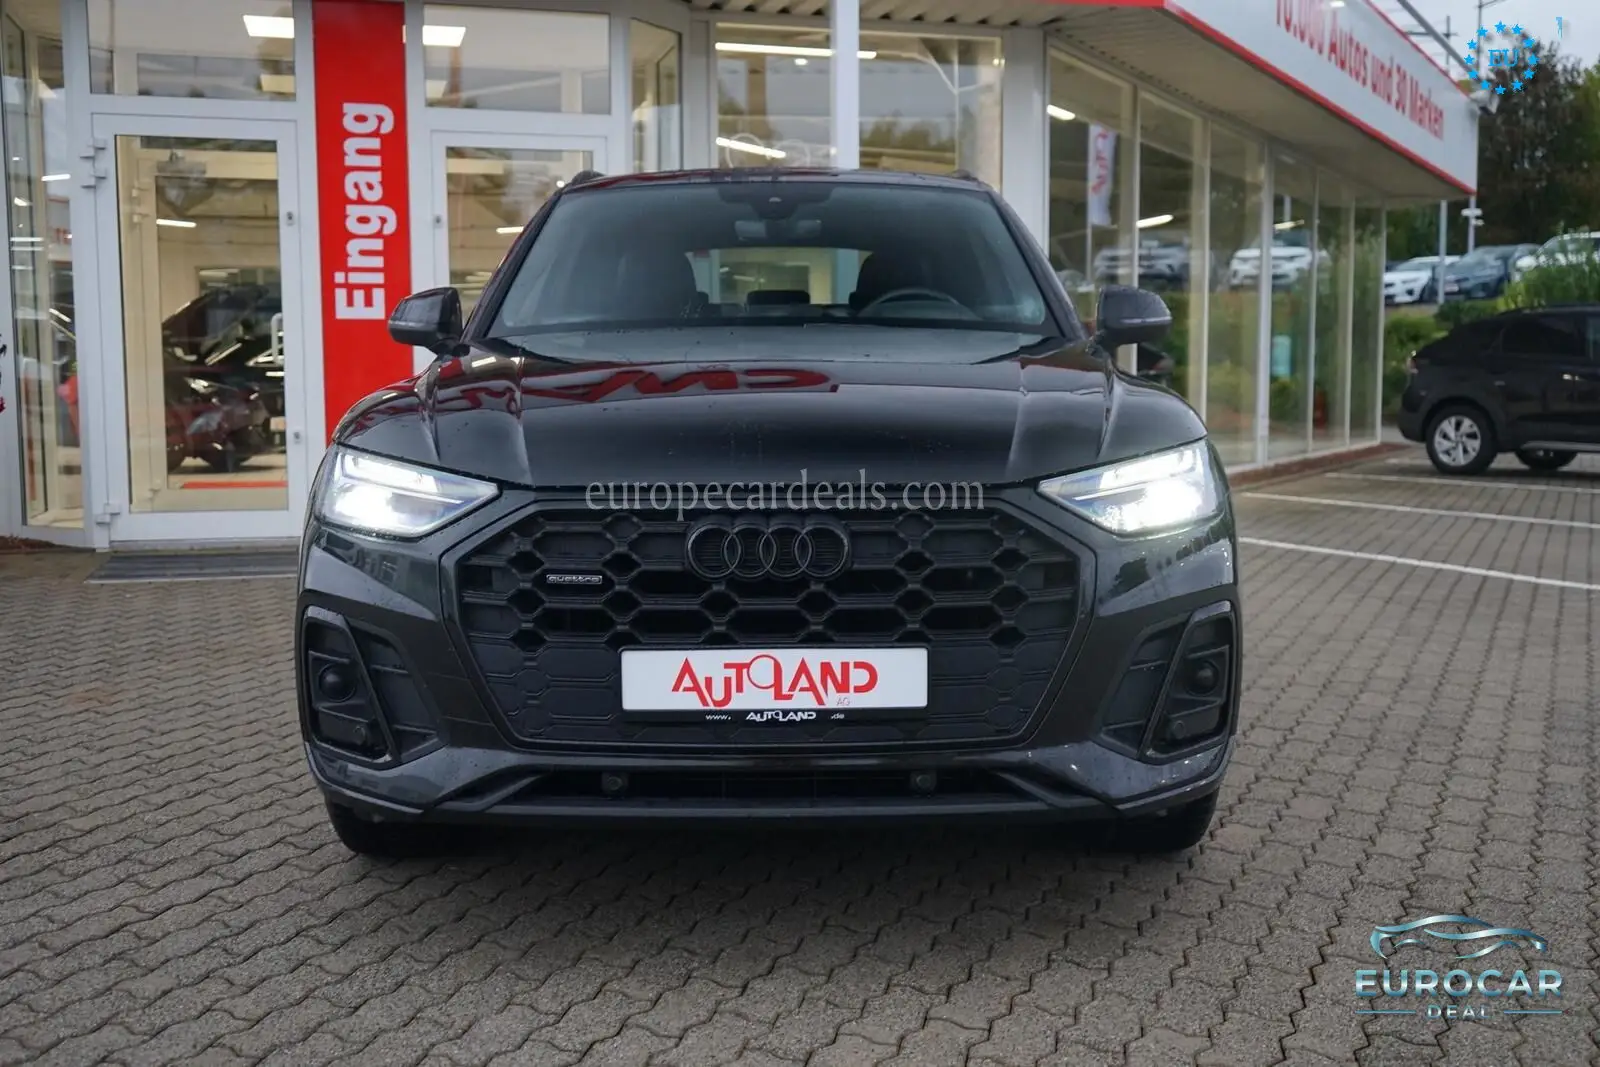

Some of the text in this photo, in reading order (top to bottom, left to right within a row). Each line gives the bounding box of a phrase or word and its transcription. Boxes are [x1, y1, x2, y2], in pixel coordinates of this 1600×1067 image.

[1328, 8, 1369, 88] Autos
[1371, 53, 1394, 105] und
[1395, 64, 1407, 116] 30
[1408, 74, 1445, 141] Marken
[334, 102, 398, 320] Eingang
[547, 575, 600, 584] quattro
[671, 654, 878, 707] AUTOLAND
[746, 710, 817, 722] AUTOLAND
